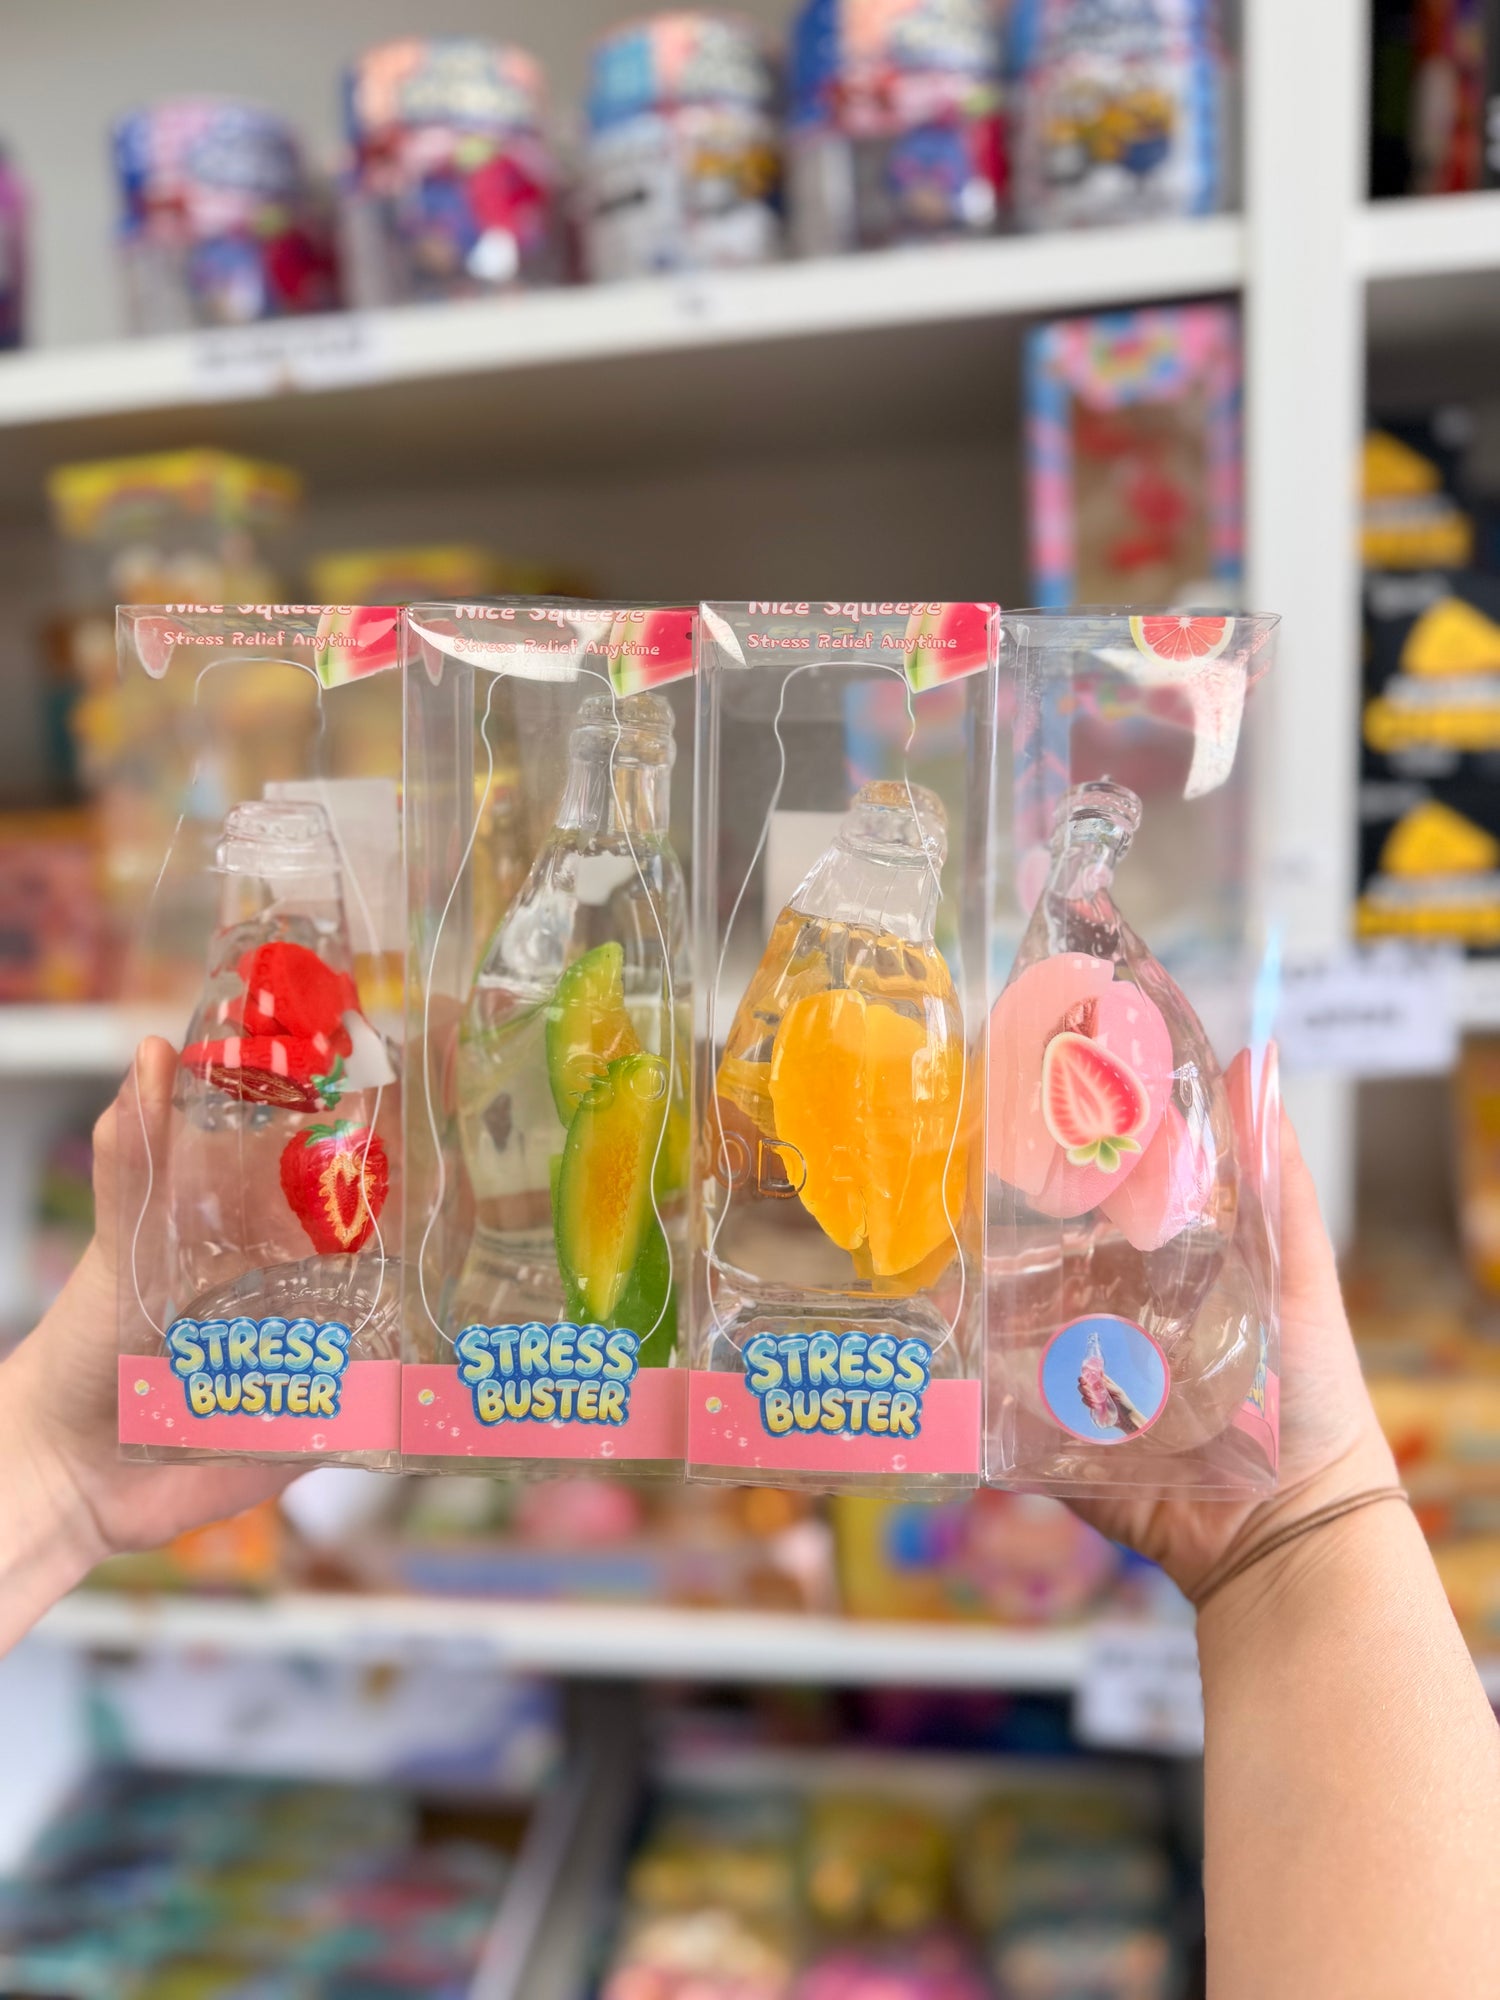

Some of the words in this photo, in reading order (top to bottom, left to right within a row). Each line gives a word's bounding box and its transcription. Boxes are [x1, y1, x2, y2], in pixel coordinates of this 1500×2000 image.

[454, 605, 516, 620] Nice
[529, 607, 646, 628] Squeeze
[748, 601, 810, 616] Nice
[822, 601, 942, 623] Squeeze
[162, 631, 225, 647] Stress
[231, 631, 286, 647] Relief
[453, 638, 518, 654] Stress
[523, 639, 579, 655] Relief
[585, 641, 661, 659] Anytime
[747, 633, 811, 649] Stress
[817, 633, 874, 649] Relief
[880, 634, 958, 654] Anytime
[170, 1318, 349, 1378] STRESS
[459, 1325, 639, 1382] STRESS
[746, 1333, 929, 1391] STRESS
[188, 1371, 339, 1417] BUSTER
[476, 1377, 629, 1424] BUSTER
[765, 1388, 918, 1434] BUSTER
